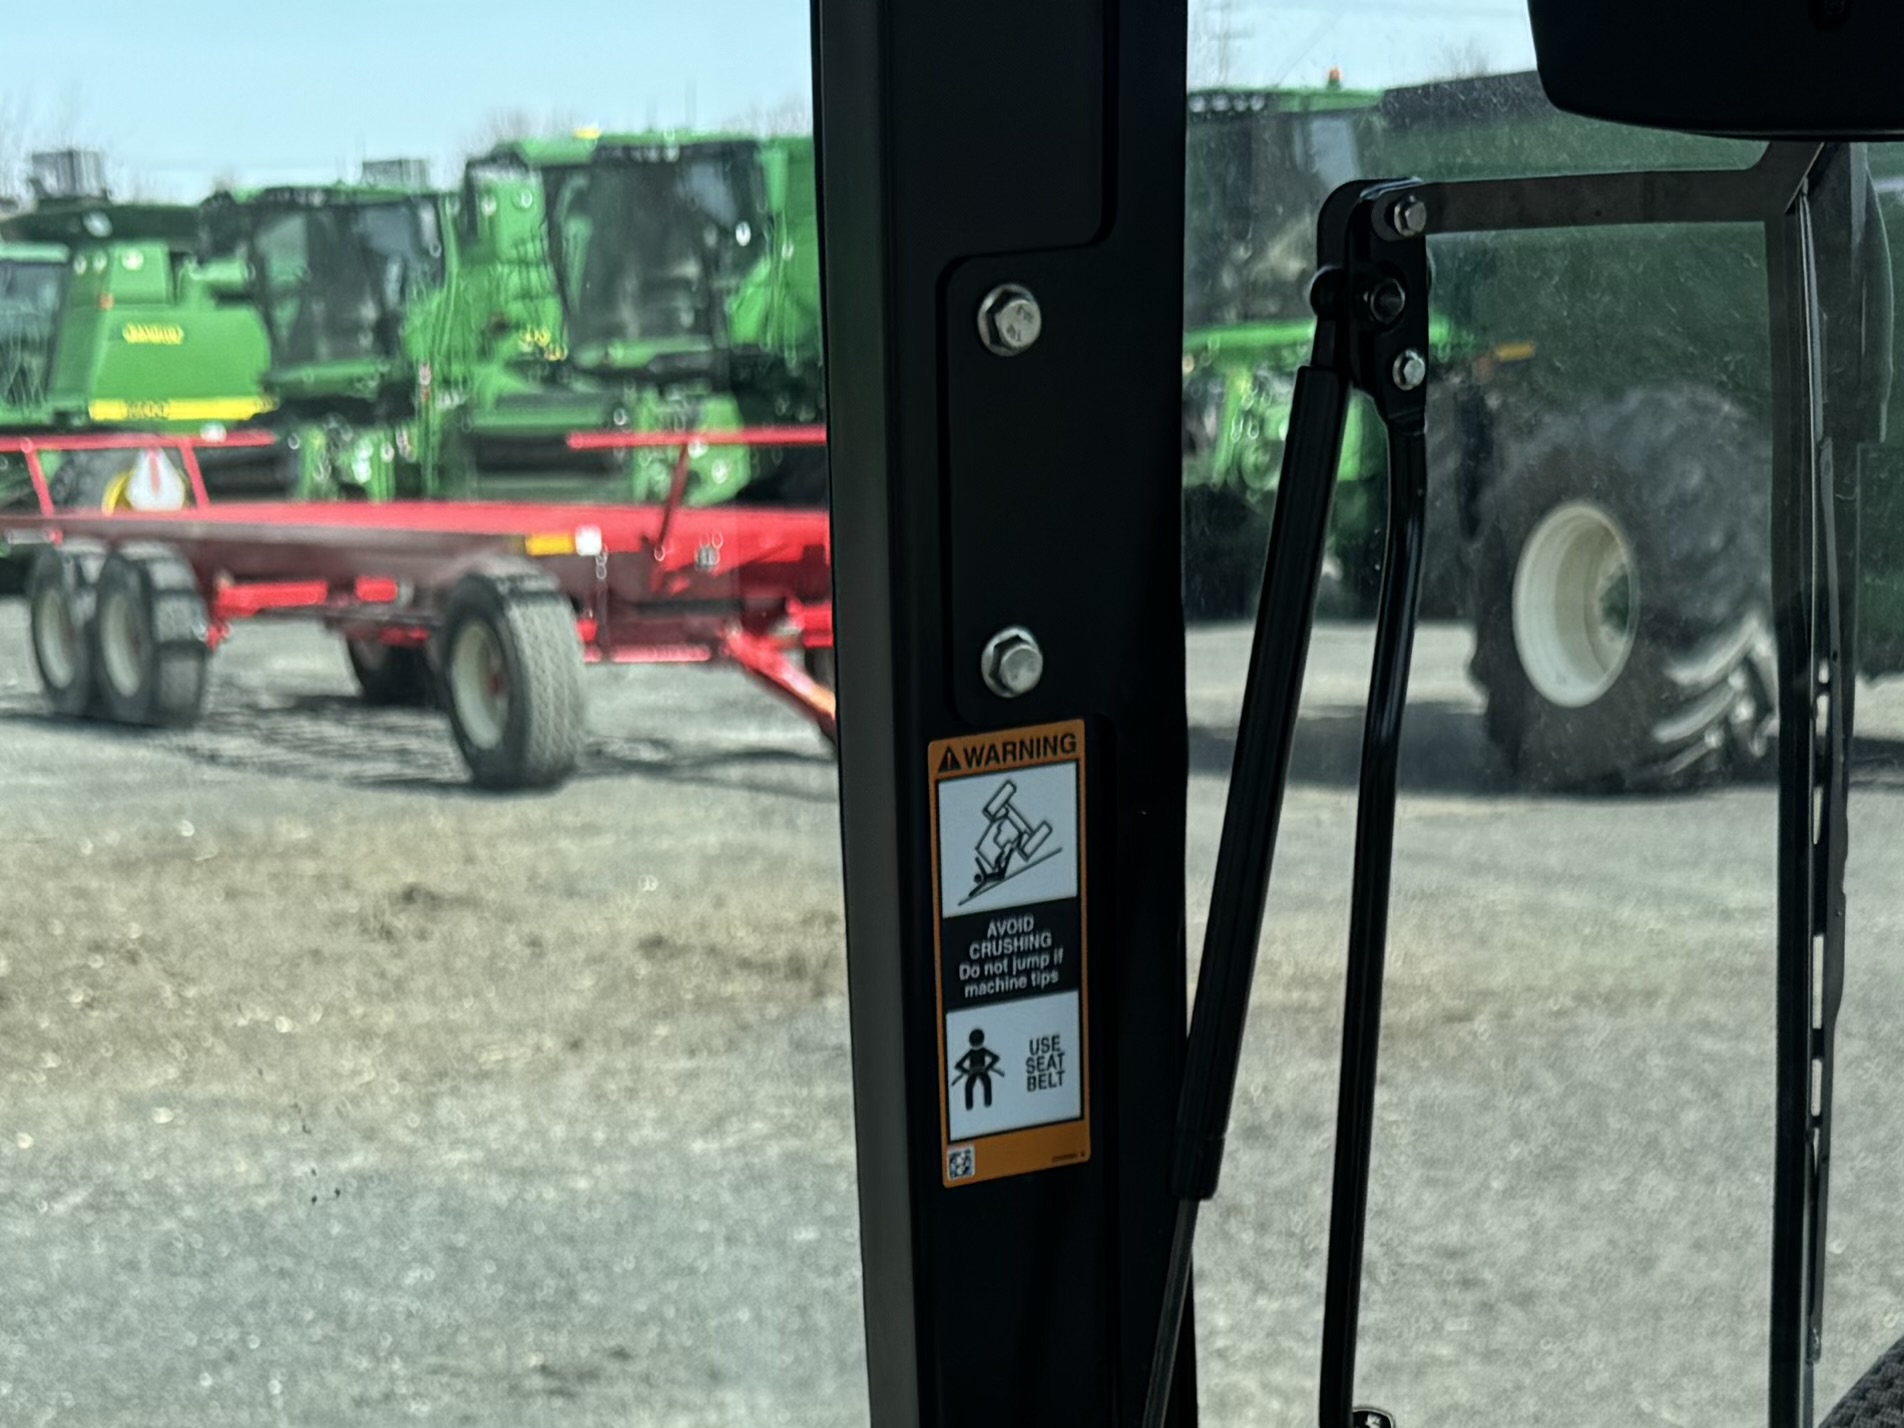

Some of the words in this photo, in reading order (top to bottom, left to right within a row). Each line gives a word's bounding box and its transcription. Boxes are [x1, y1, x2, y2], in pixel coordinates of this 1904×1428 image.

[963, 732, 1077, 769] WARNING
[986, 915, 1035, 937] AVOID
[968, 932, 1052, 960] CRUSHING
[960, 963, 981, 980] Do
[983, 957, 1009, 976] not
[1012, 953, 1050, 976] jump
[1053, 948, 1064, 965] if
[964, 976, 1026, 999] machine
[1030, 970, 1060, 989] tips
[1028, 1034, 1062, 1055] USE
[1026, 1052, 1065, 1074] SEAT
[1026, 1071, 1065, 1092] BELT
